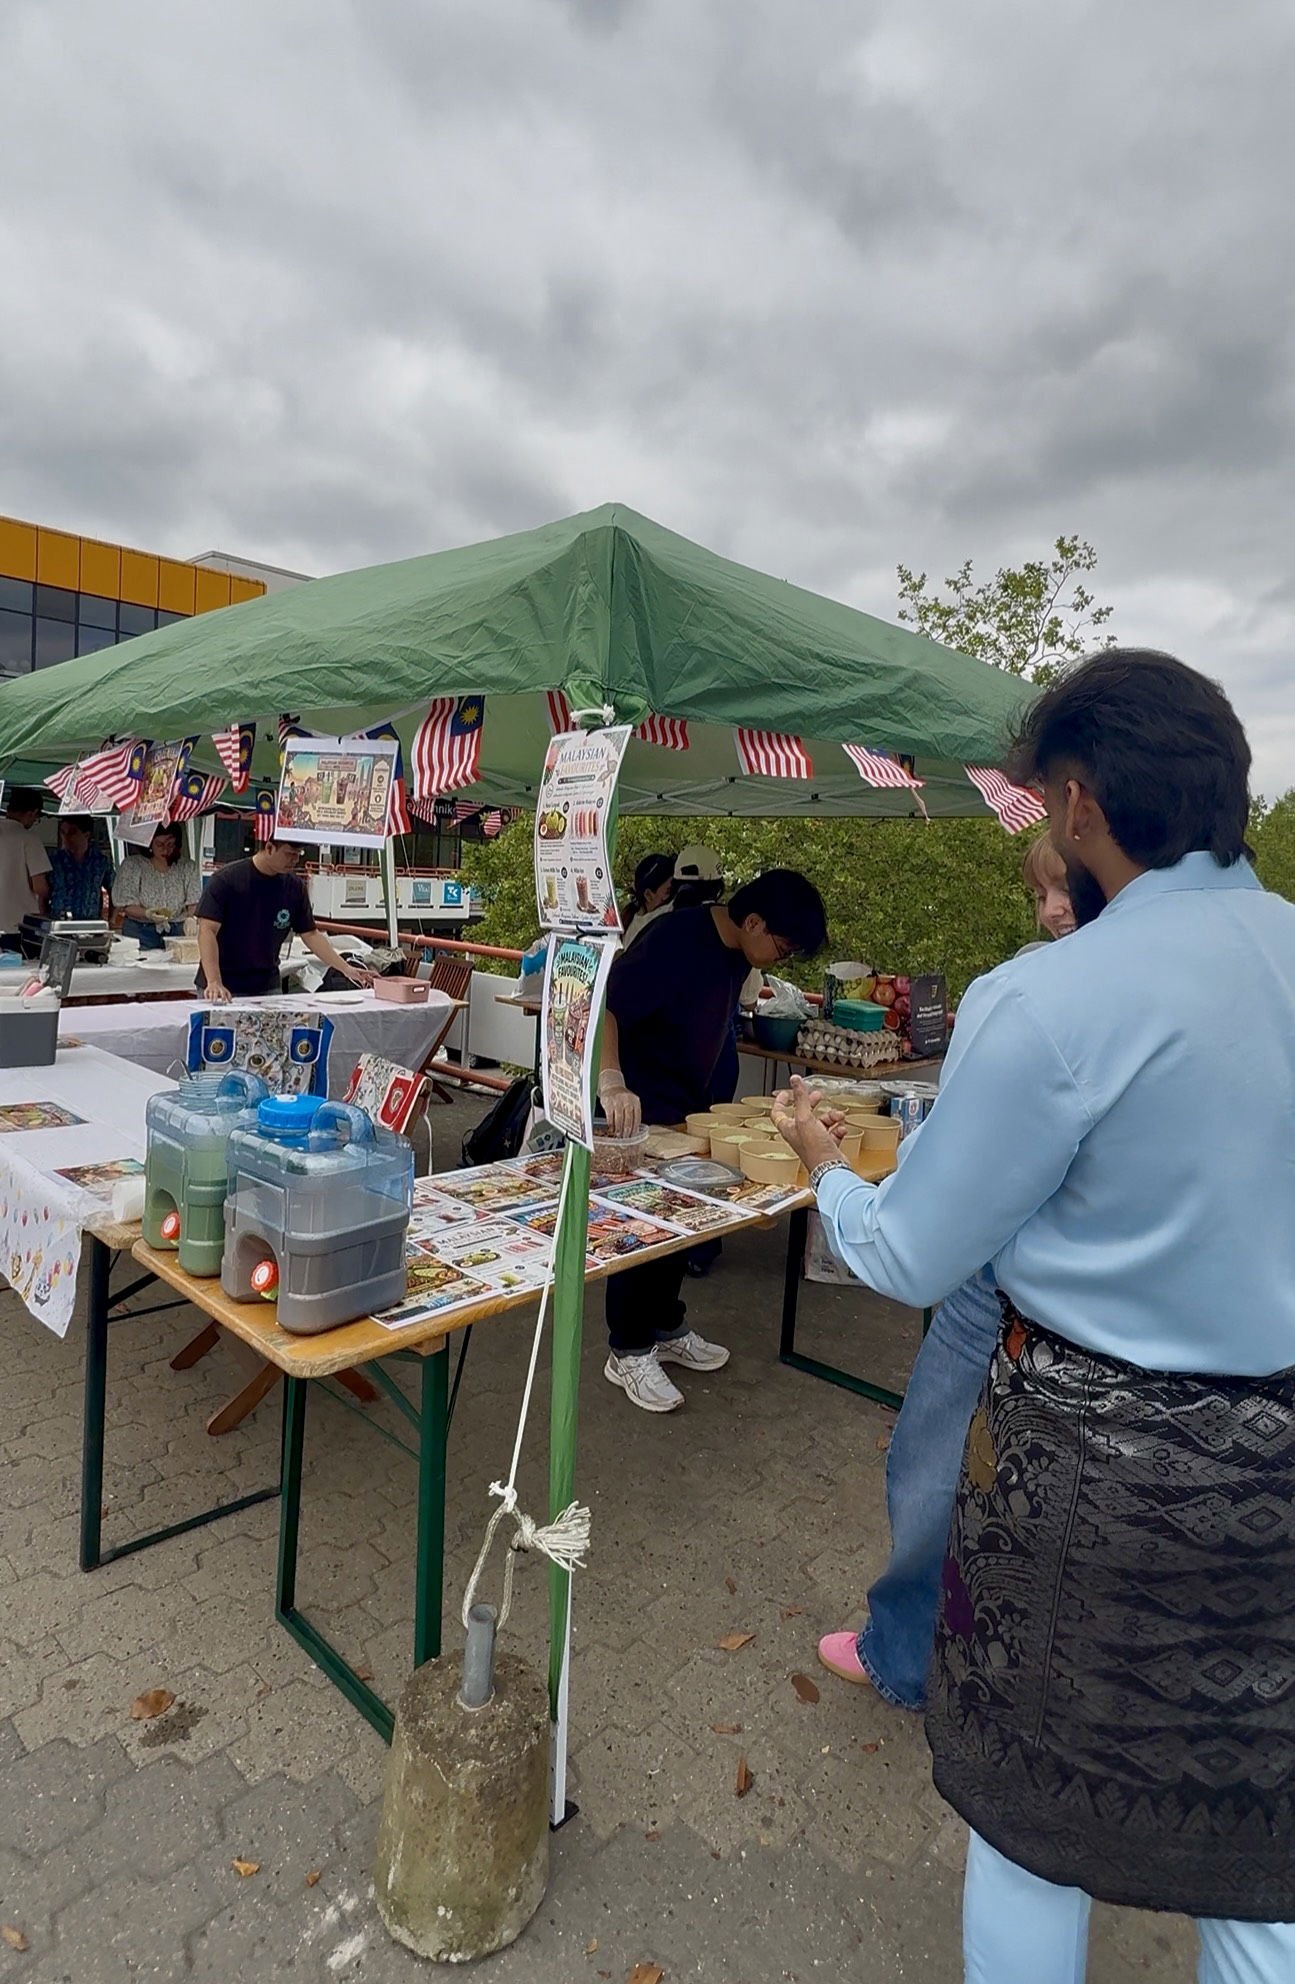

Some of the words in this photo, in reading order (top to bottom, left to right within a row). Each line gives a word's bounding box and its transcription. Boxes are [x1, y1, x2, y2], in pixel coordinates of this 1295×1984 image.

[560, 747, 606, 763] MALAYSIAN
[560, 761, 600, 776] FAVOURITES
[560, 952, 590, 969] MALAYSIAN
[557, 966, 588, 983] FAVOURITES!
